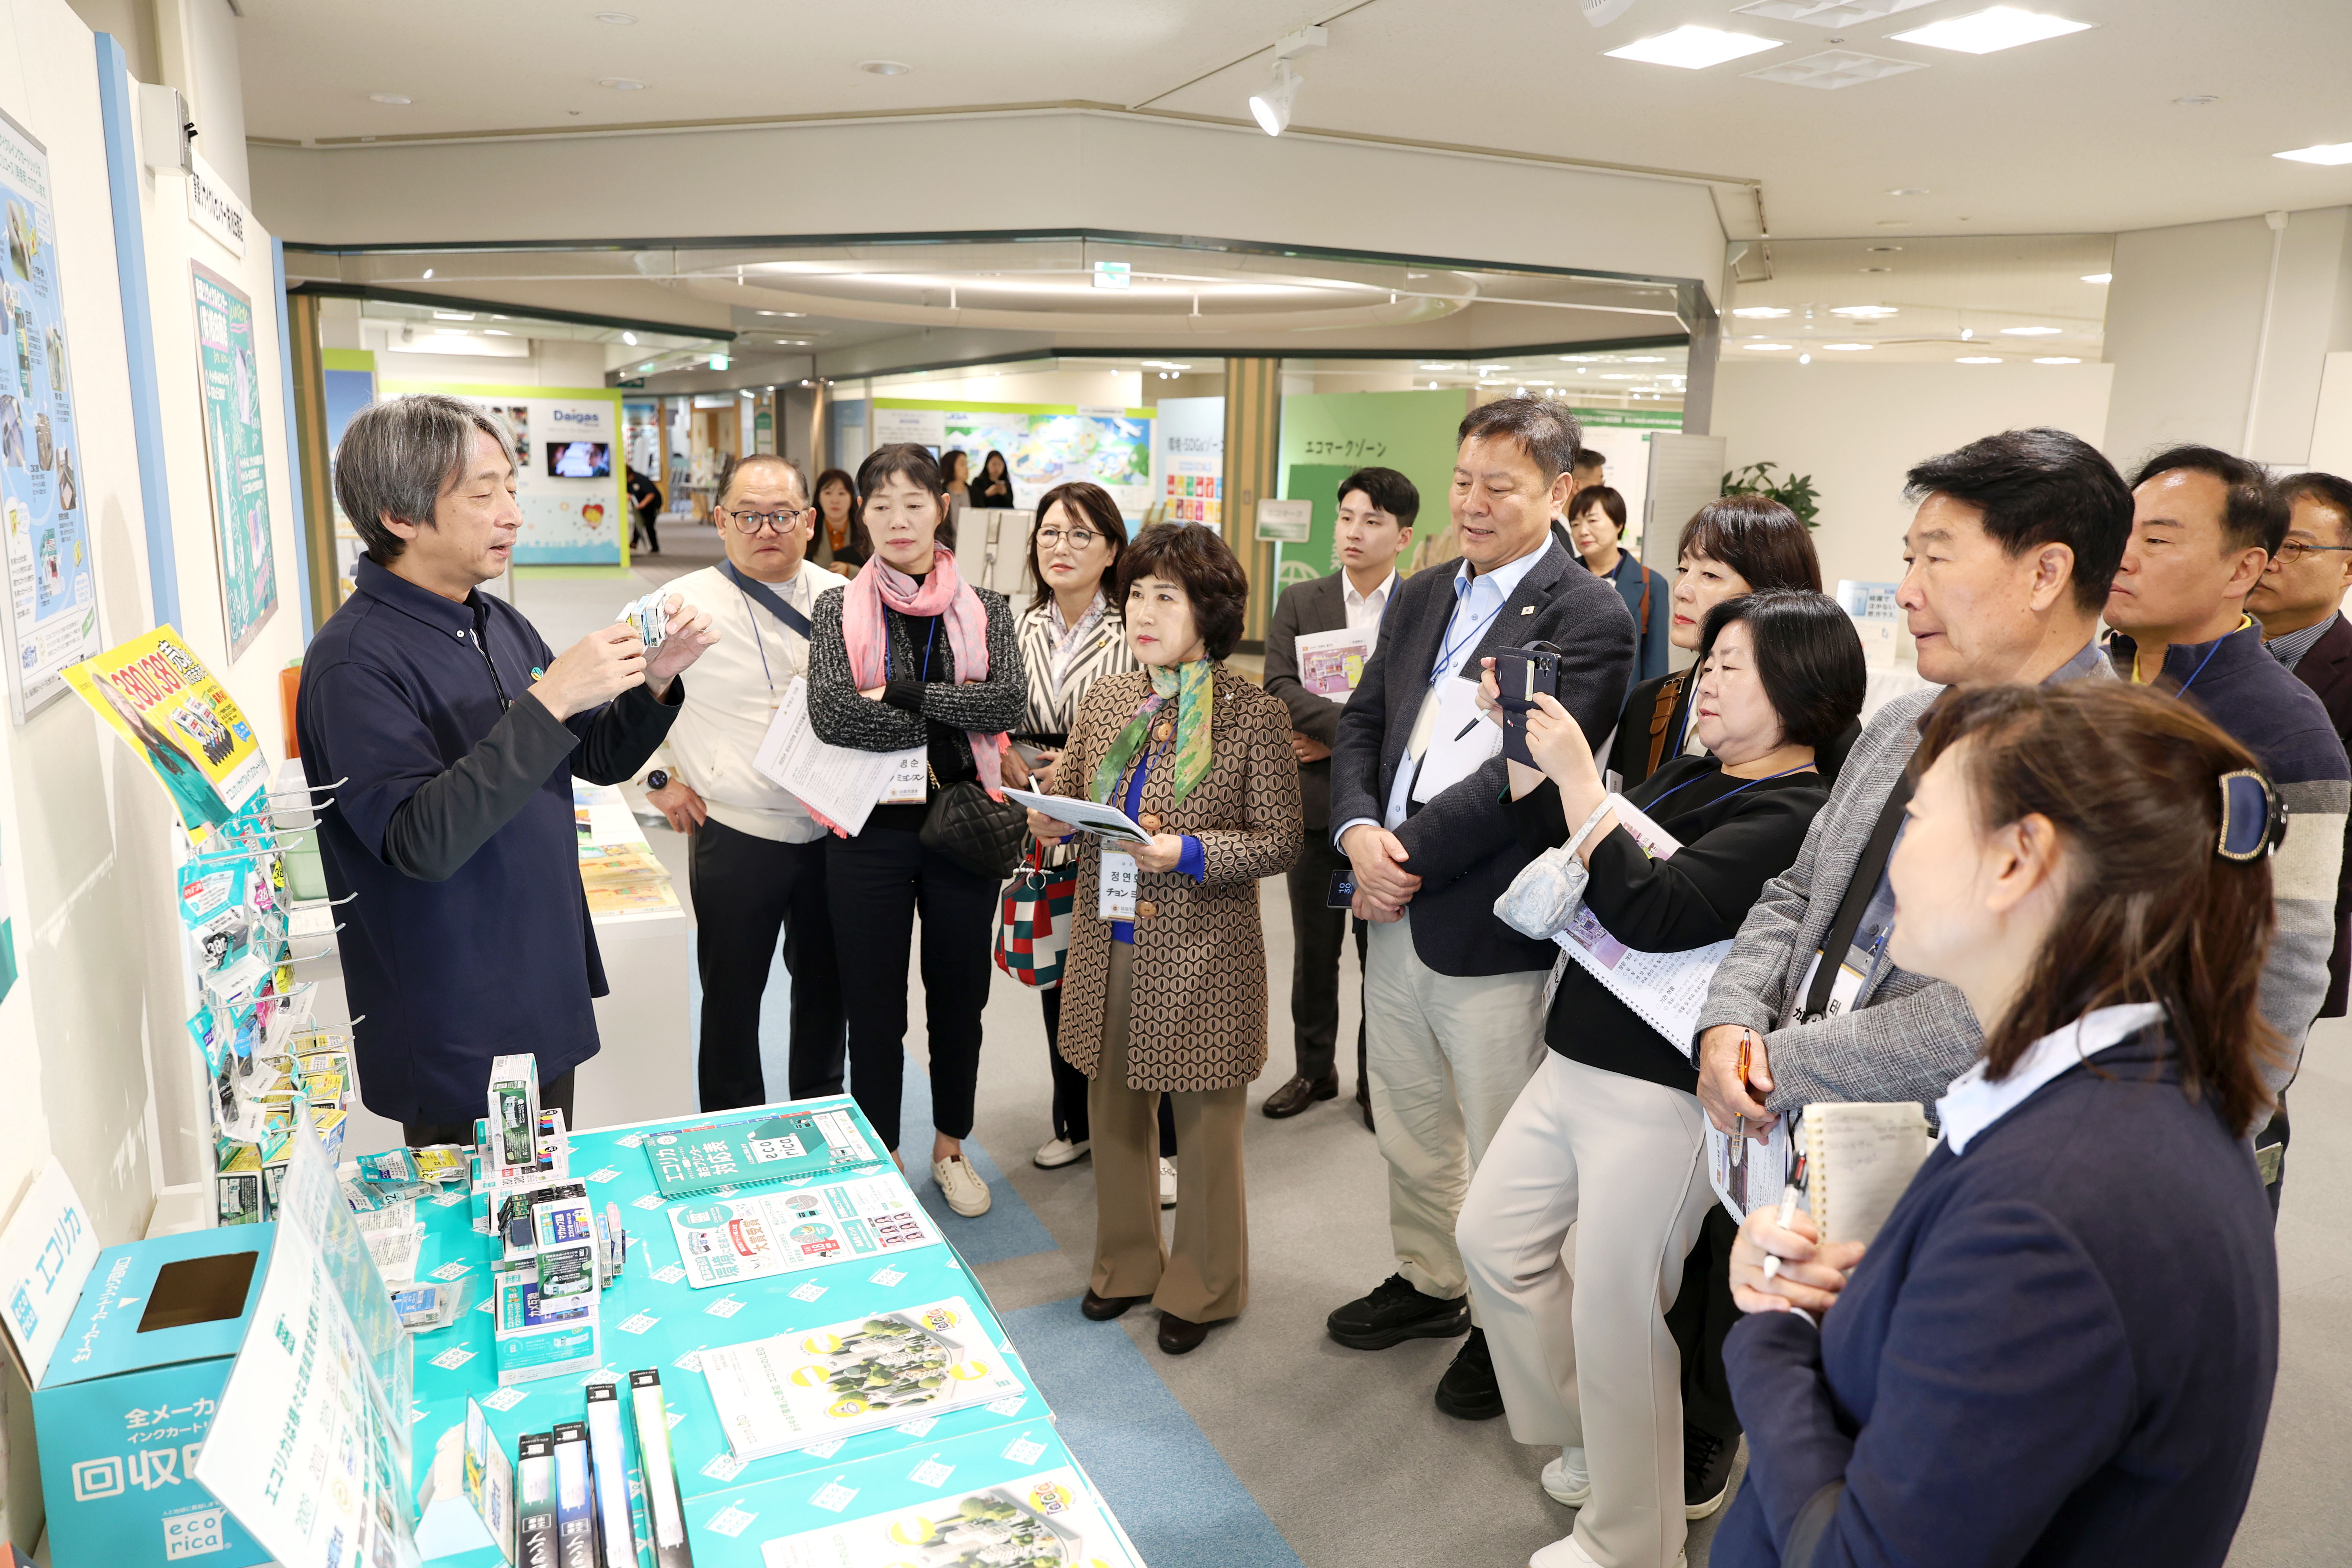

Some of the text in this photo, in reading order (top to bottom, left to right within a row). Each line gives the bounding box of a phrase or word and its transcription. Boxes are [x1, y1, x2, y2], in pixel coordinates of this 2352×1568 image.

[554, 409, 599, 422] Daigas
[1305, 439, 1387, 457] エコマークゾーン
[111, 652, 187, 711] 380/381
[620, 1134, 639, 1147] eco
[779, 1138, 799, 1156] rica
[702, 1140, 739, 1176] 対応表
[760, 1141, 778, 1160] eco
[656, 1149, 684, 1182] エコリカ
[689, 1145, 711, 1178] 適合プリンター
[514, 1176, 525, 1185] 300
[592, 1170, 608, 1181] eco
[604, 1170, 617, 1181] rica
[437, 1193, 456, 1203] eco
[444, 1195, 463, 1205] rica
[639, 1197, 654, 1208] eco
[646, 1198, 664, 1209] rica
[742, 1218, 771, 1252] 大賞受賞
[36, 1206, 82, 1295] エコリカ
[439, 1262, 458, 1276] eco
[448, 1266, 465, 1279] rica
[658, 1268, 675, 1279] eco
[666, 1270, 684, 1283] rica
[877, 1271, 892, 1283] eco
[886, 1273, 901, 1285] rica
[797, 1286, 813, 1298] eco
[805, 1286, 822, 1301] rica
[714, 1303, 731, 1316] eco
[723, 1301, 742, 1317] rica
[625, 1316, 644, 1330] eco
[635, 1319, 654, 1332] rica
[439, 1349, 459, 1367] eco
[449, 1353, 469, 1367] rica
[756, 1347, 777, 1383] エコリカのLED
[490, 1390, 512, 1406] eco
[499, 1393, 523, 1409] rica
[127, 1421, 208, 1444] インクカート
[1009, 1442, 1031, 1458] eco
[1019, 1445, 1041, 1463] rica
[309, 1444, 325, 1482] 2010
[717, 1459, 739, 1474] eco
[916, 1463, 939, 1480] eco
[926, 1467, 949, 1485] rica
[818, 1486, 840, 1504] eco
[830, 1492, 852, 1510] rica
[295, 1492, 310, 1535] 2009
[715, 1511, 739, 1530] eco
[170, 1518, 216, 1535] eco
[726, 1515, 749, 1533] rica
[172, 1535, 218, 1553] rica
